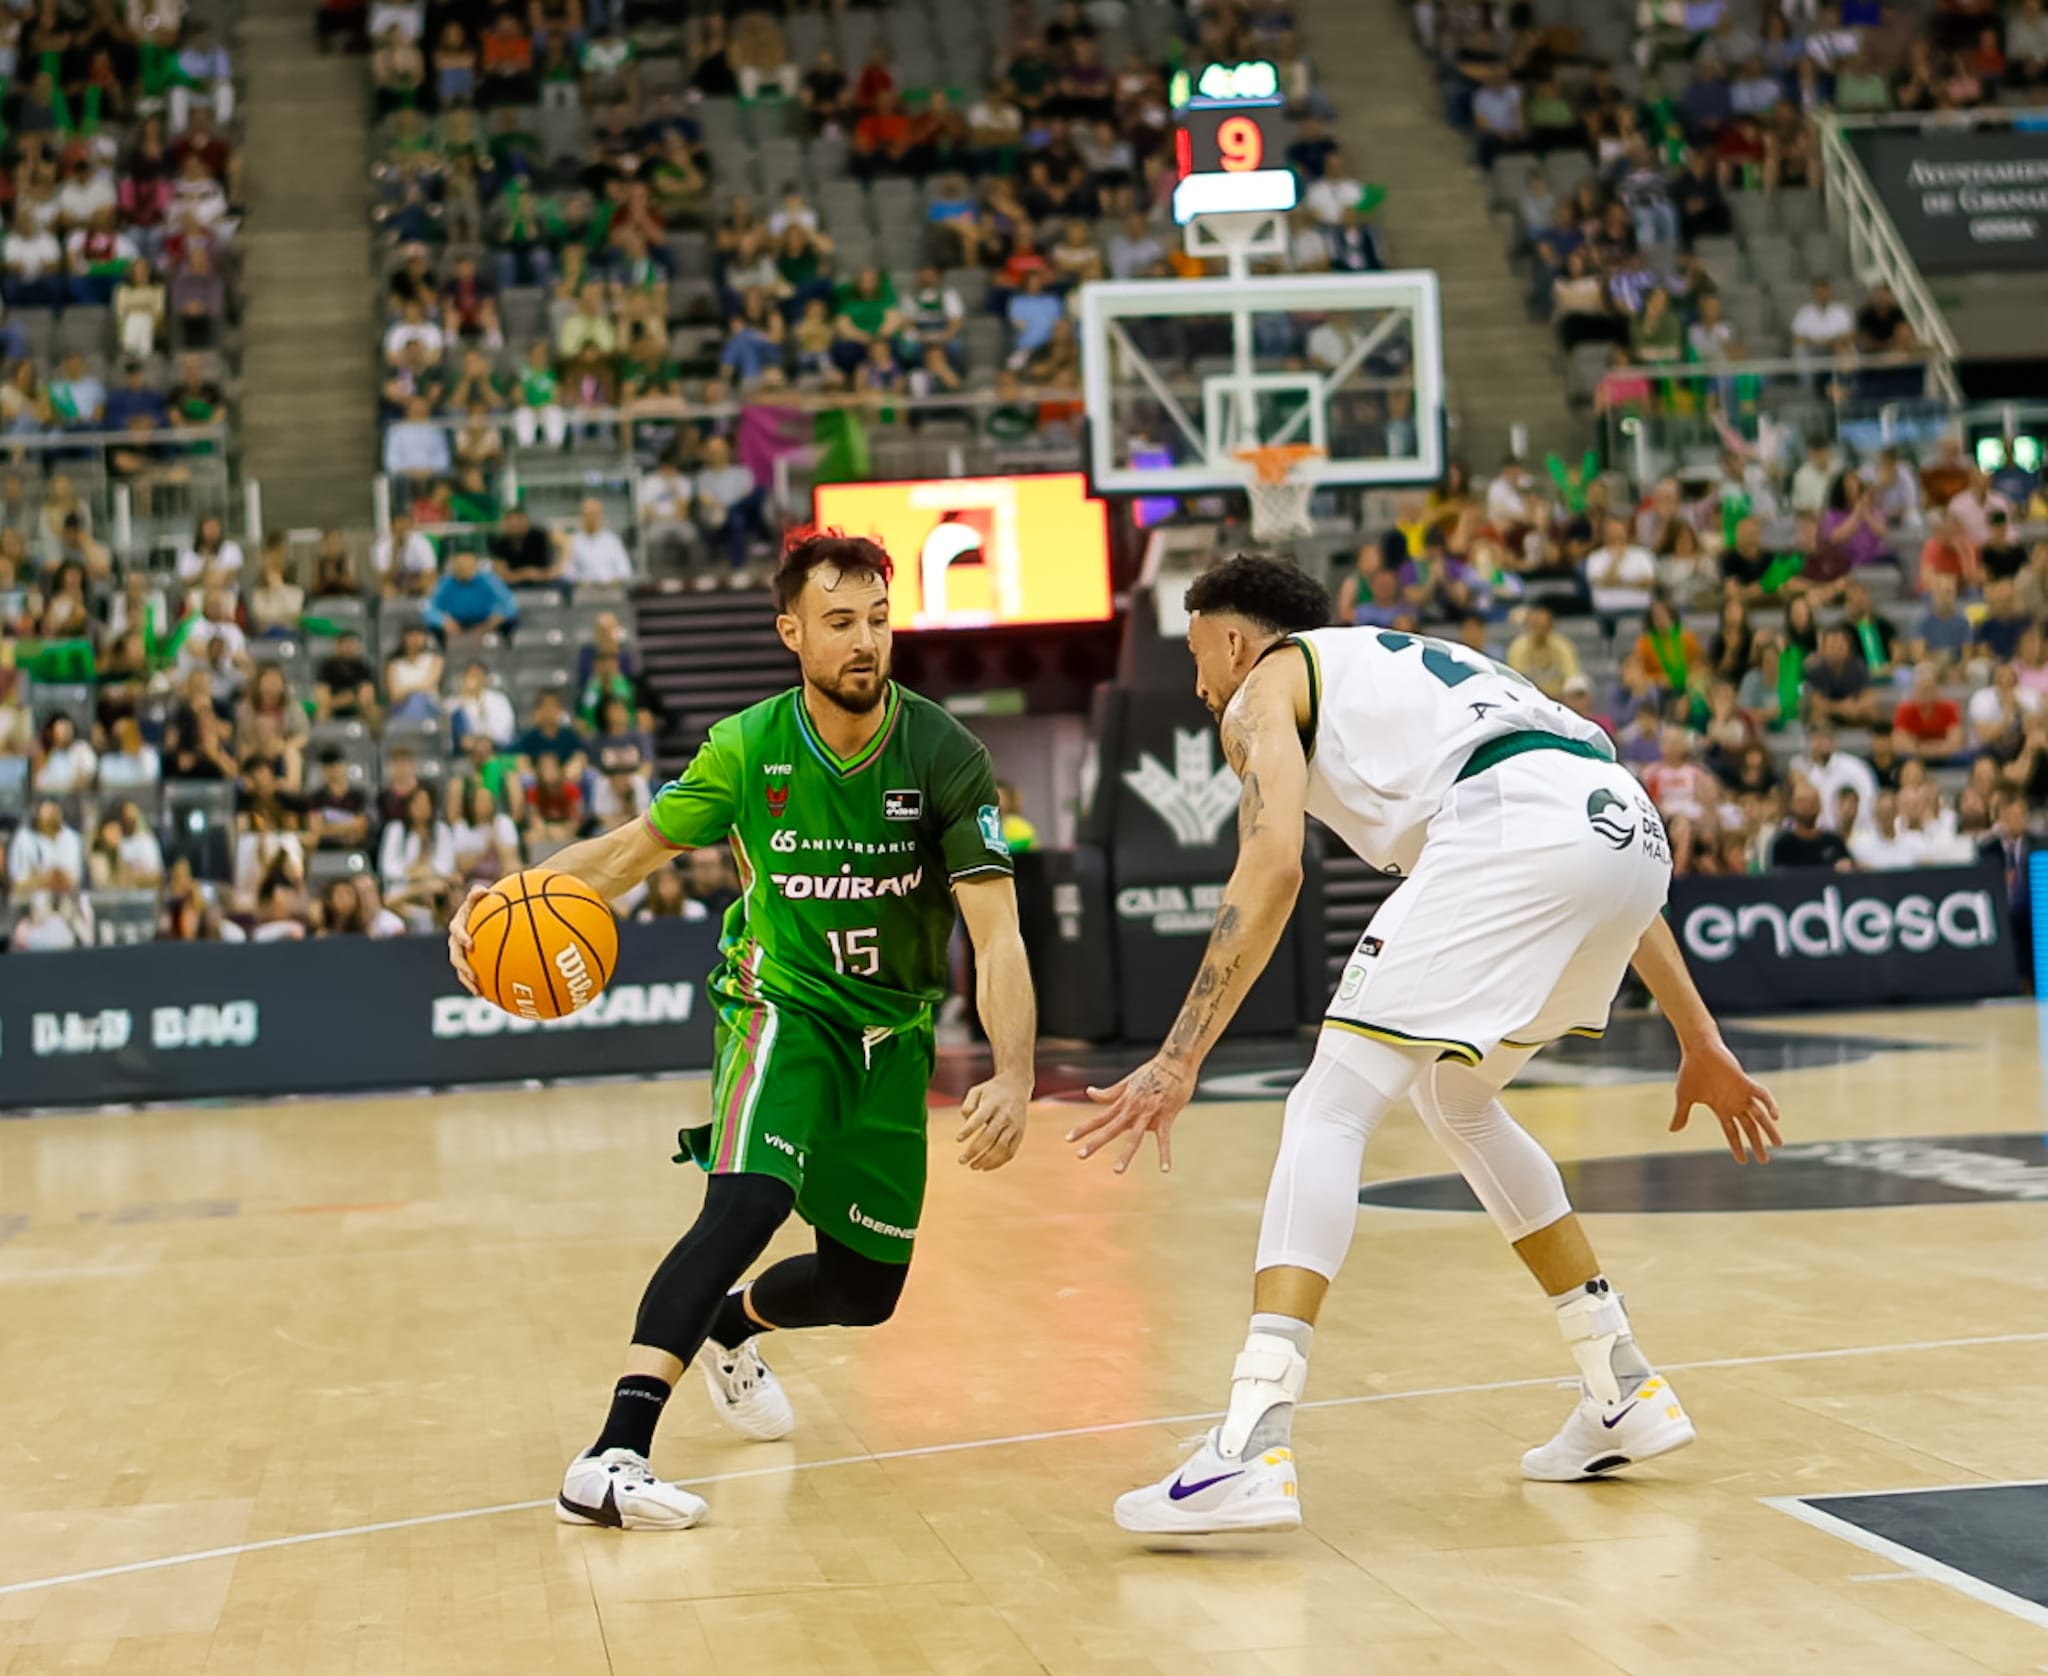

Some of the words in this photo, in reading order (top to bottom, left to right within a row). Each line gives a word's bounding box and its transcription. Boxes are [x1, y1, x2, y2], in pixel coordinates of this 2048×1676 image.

[1217, 116, 1262, 172] 9
[770, 830, 797, 853] 65
[1684, 885, 1996, 960] endesa
[827, 928, 879, 977] 15
[861, 1215, 917, 1239] BERNE
